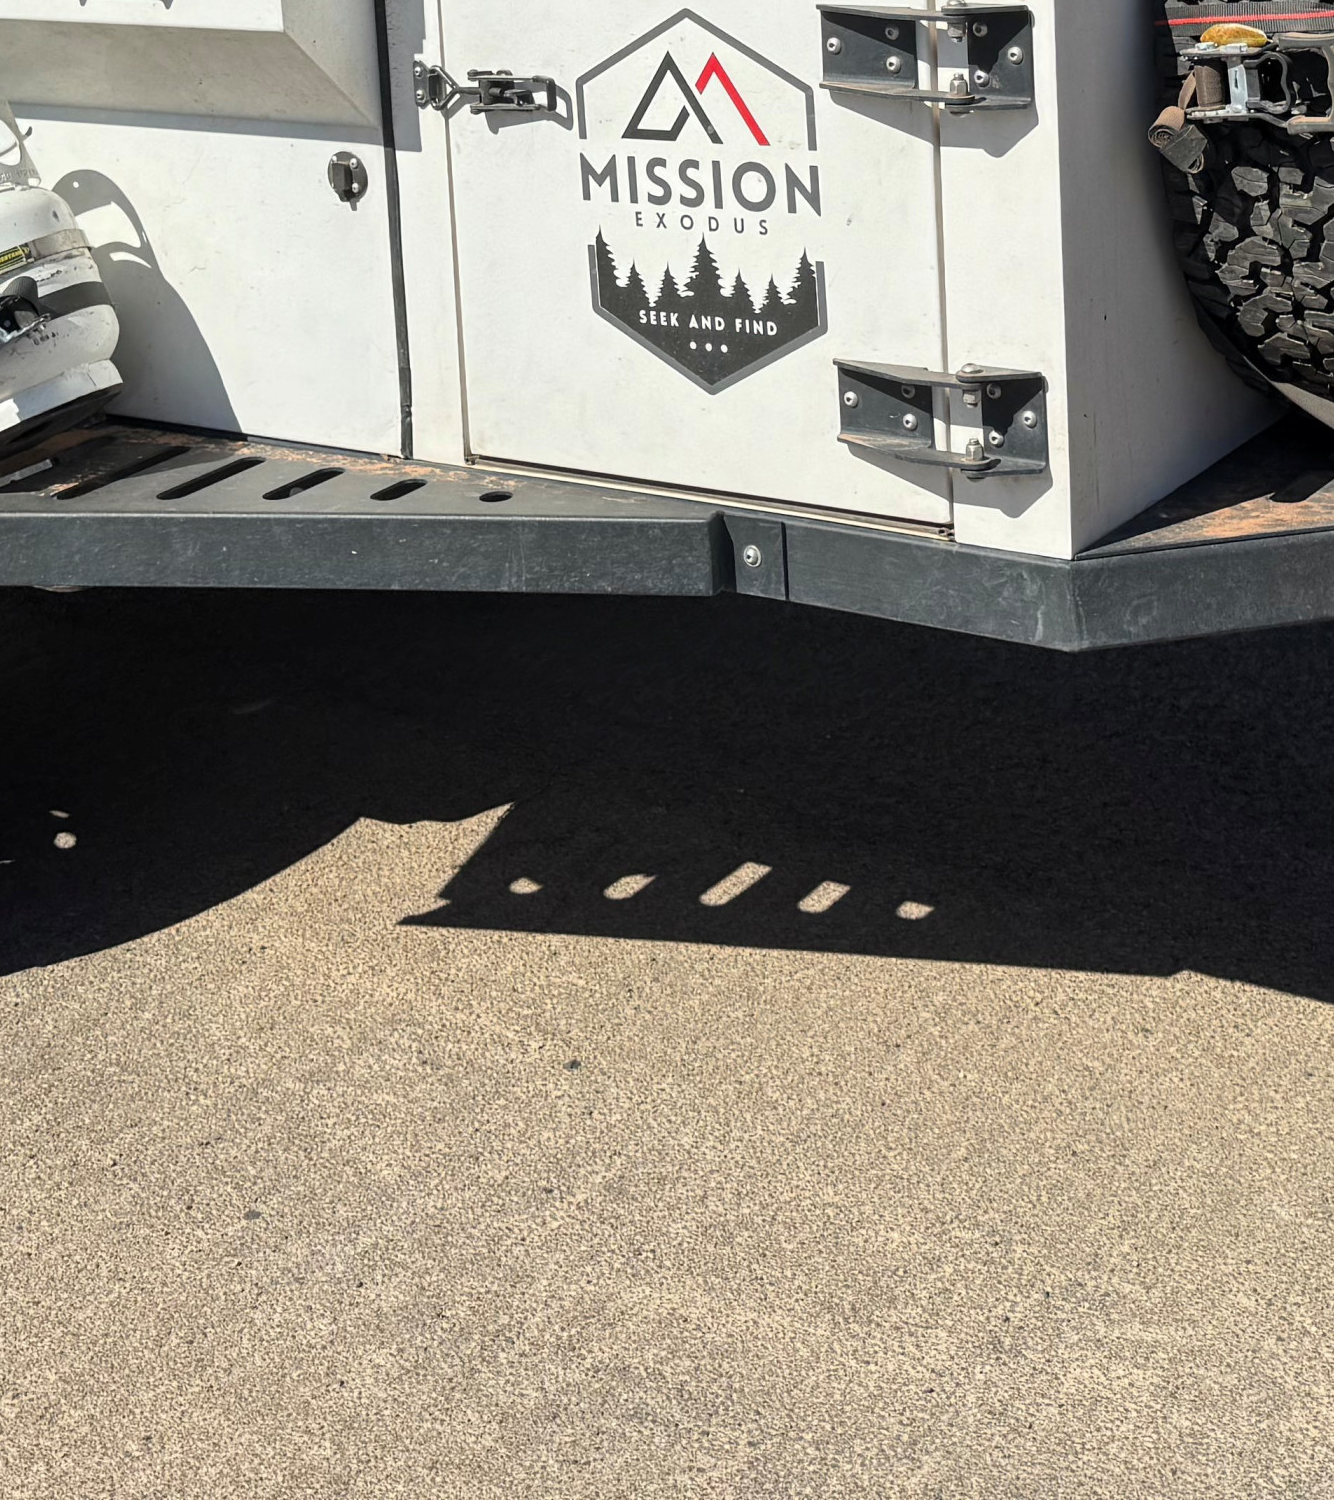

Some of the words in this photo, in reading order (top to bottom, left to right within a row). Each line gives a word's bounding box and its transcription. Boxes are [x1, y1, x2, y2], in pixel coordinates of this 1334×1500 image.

[579, 152, 822, 217] MISSION
[635, 211, 769, 236] EXODUS
[639, 309, 680, 328] SEEK
[689, 314, 726, 331] AND
[735, 318, 778, 337] FIND
